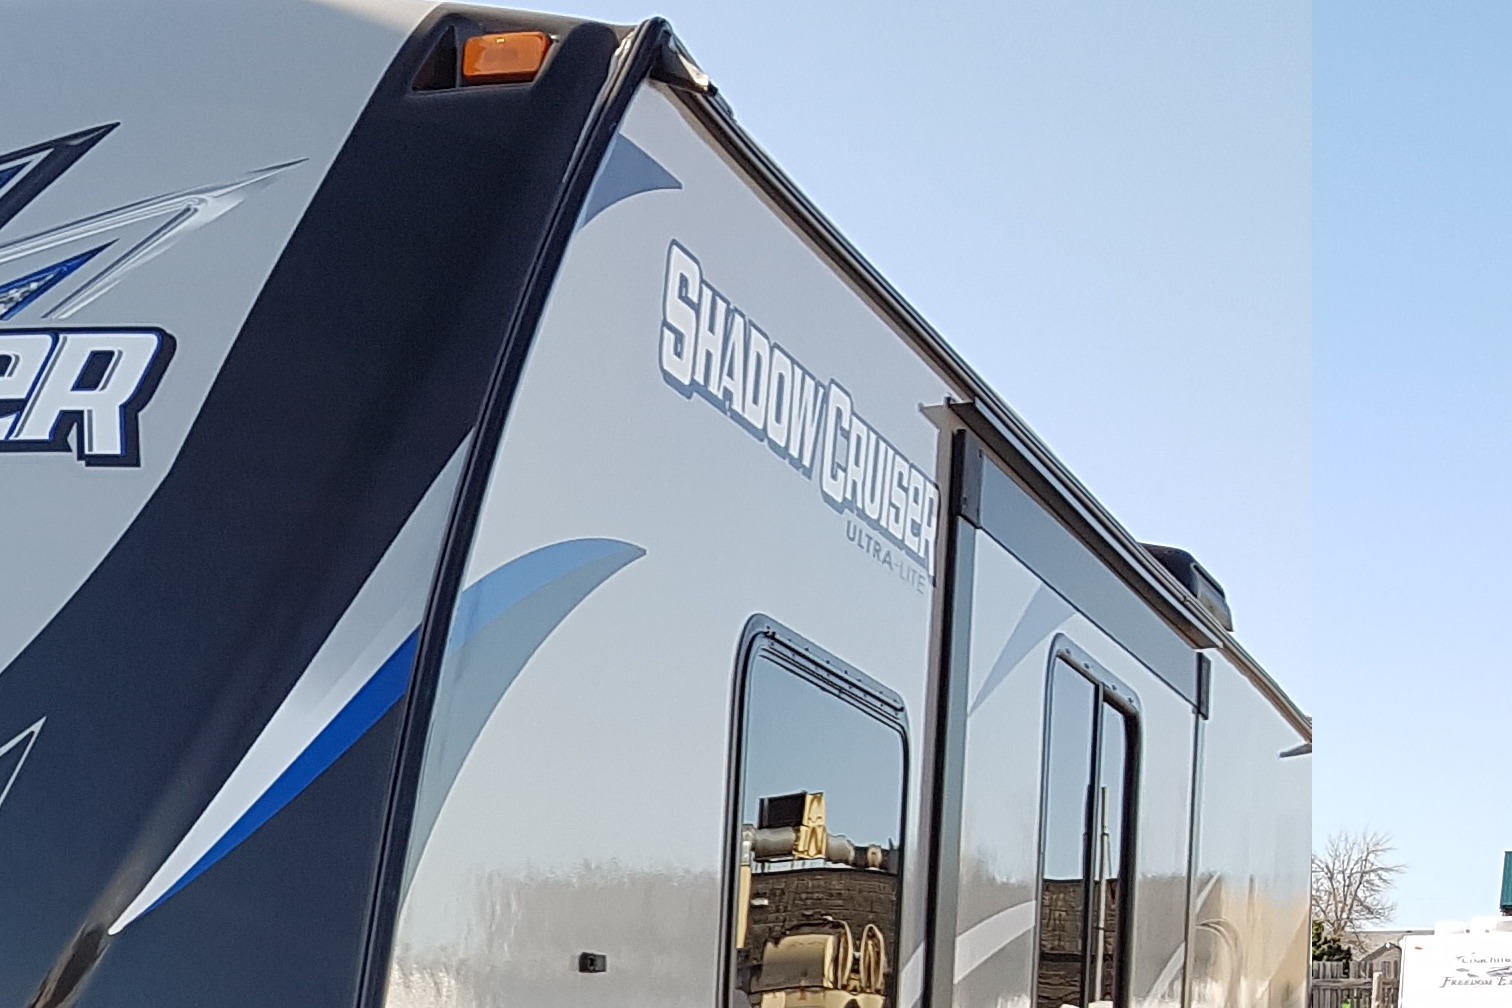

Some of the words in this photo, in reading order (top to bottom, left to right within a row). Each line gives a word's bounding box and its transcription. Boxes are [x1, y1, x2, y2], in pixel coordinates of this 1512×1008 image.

[659, 239, 825, 481] SHADOW
[846, 520, 927, 595] ULTRA-LITE
[1439, 976, 1493, 988] FREEDOM
